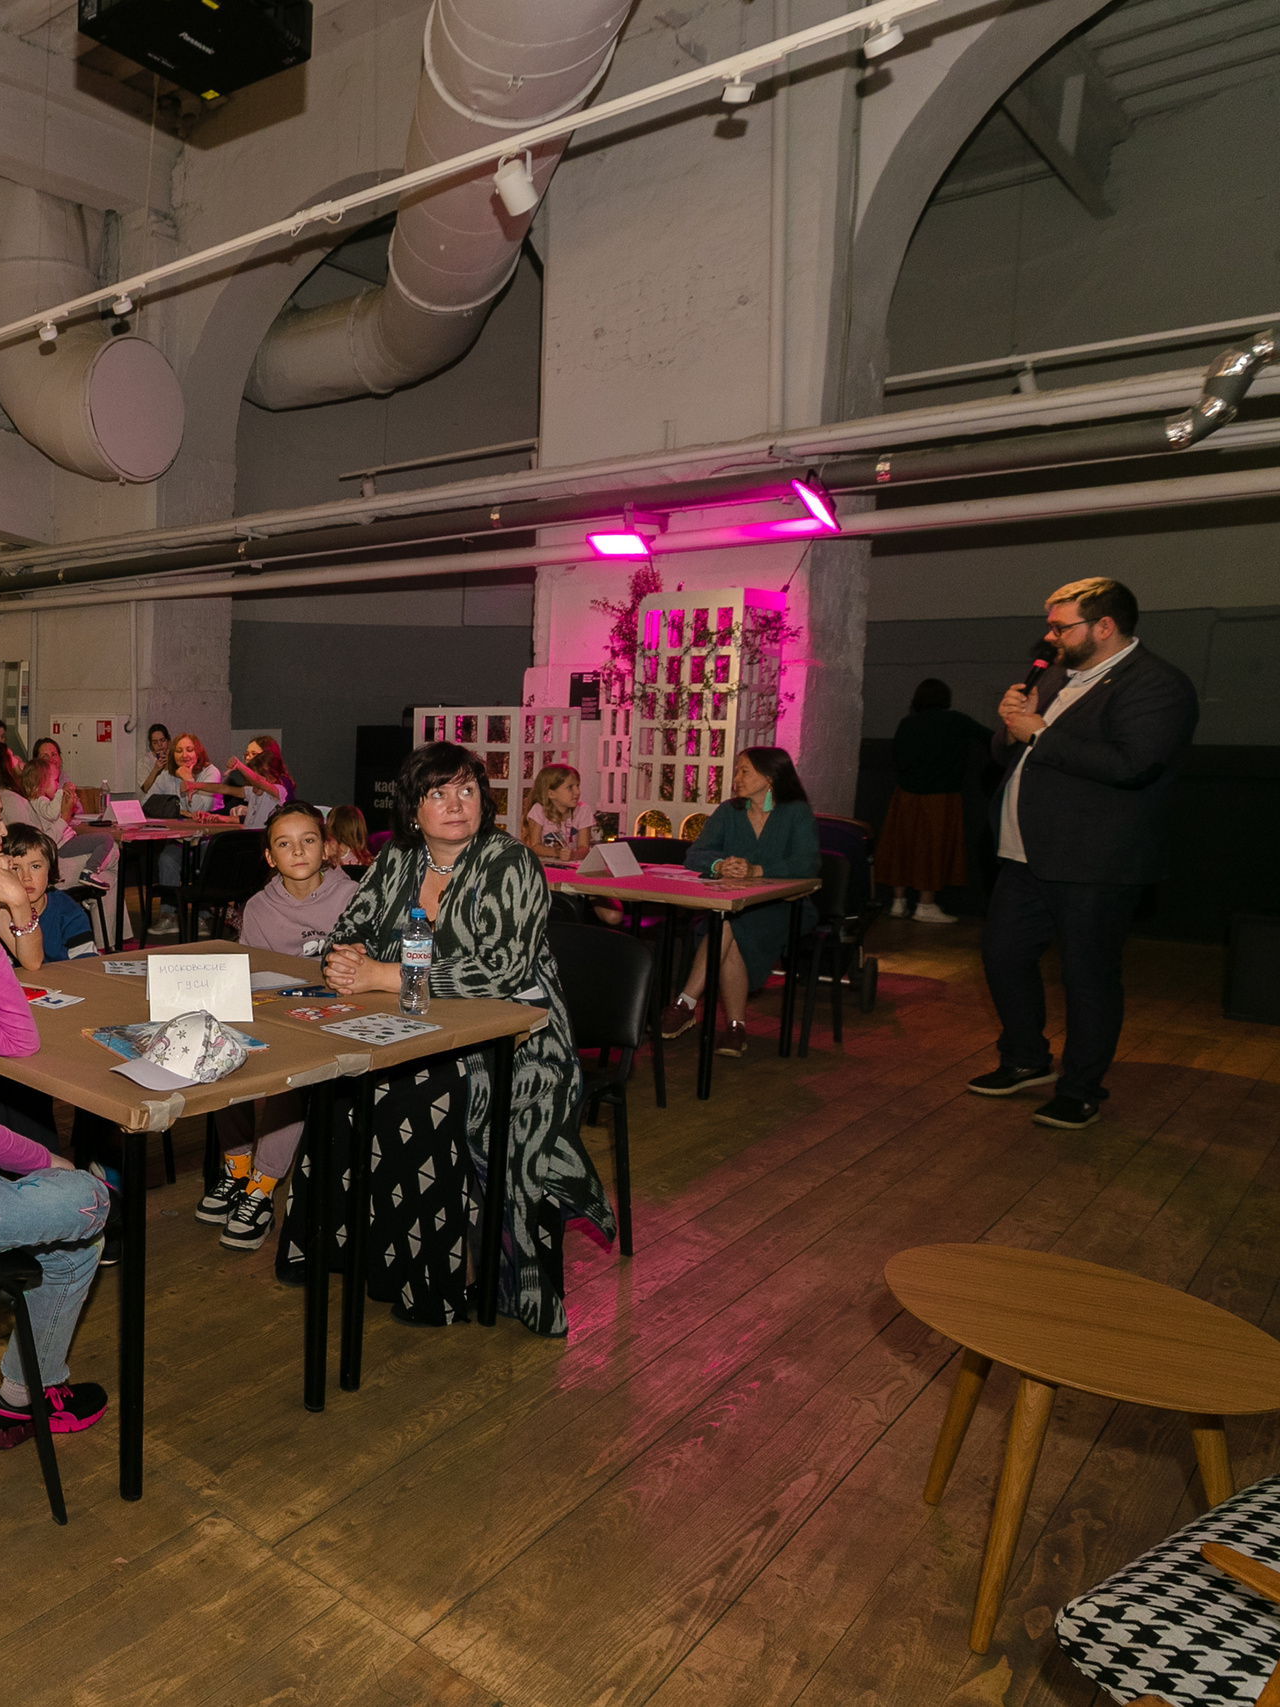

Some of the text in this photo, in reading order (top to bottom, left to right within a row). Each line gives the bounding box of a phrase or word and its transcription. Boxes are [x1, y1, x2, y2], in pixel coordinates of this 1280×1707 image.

[374, 780, 398, 796] каф
[159, 963, 228, 975] МОСКОВСКИЕ
[176, 979, 210, 991] ГУСИ
